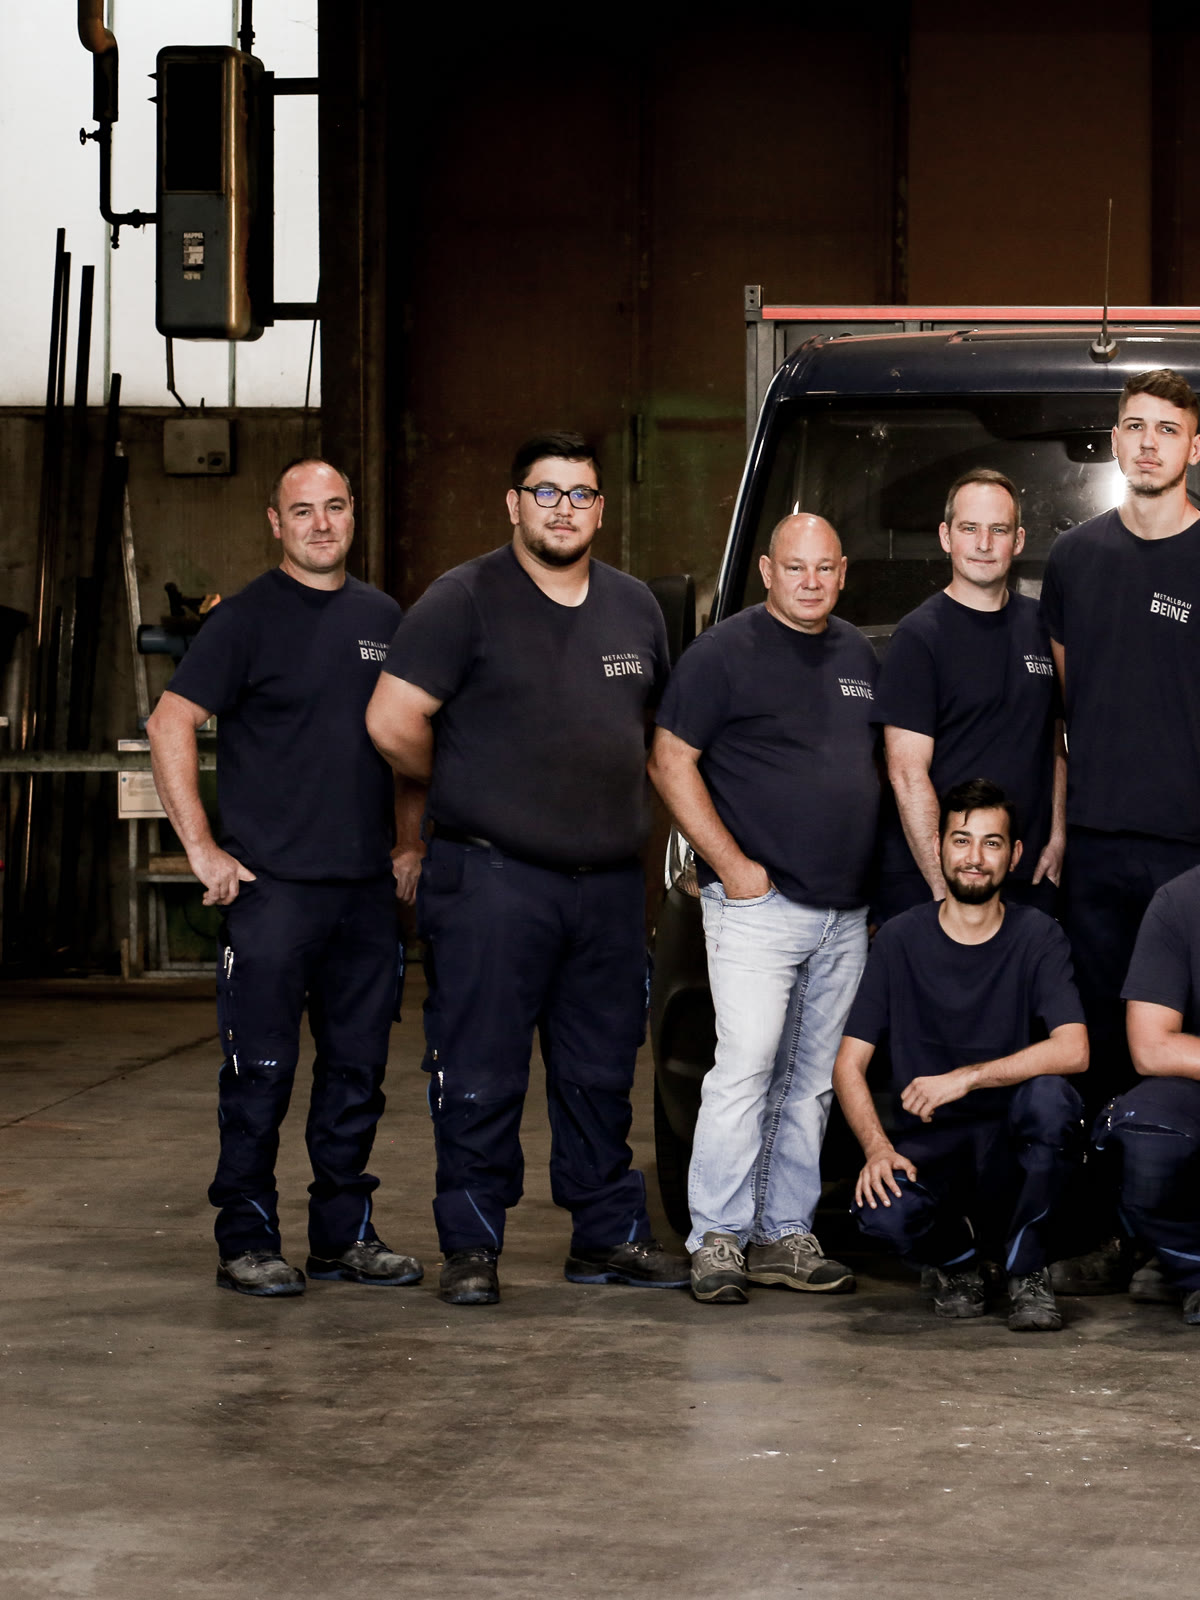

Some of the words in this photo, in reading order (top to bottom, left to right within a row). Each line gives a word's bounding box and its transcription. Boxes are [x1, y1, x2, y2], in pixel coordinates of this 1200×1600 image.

[1153, 592, 1192, 610] METALLBAU
[1150, 600, 1190, 624] BEINE
[360, 647, 387, 662] BEIN
[601, 653, 639, 662] METALLBAU
[603, 661, 643, 677] BEINE
[1025, 661, 1054, 677] BEINE
[838, 677, 871, 688] METALLBAU
[840, 685, 875, 700] BEINE
